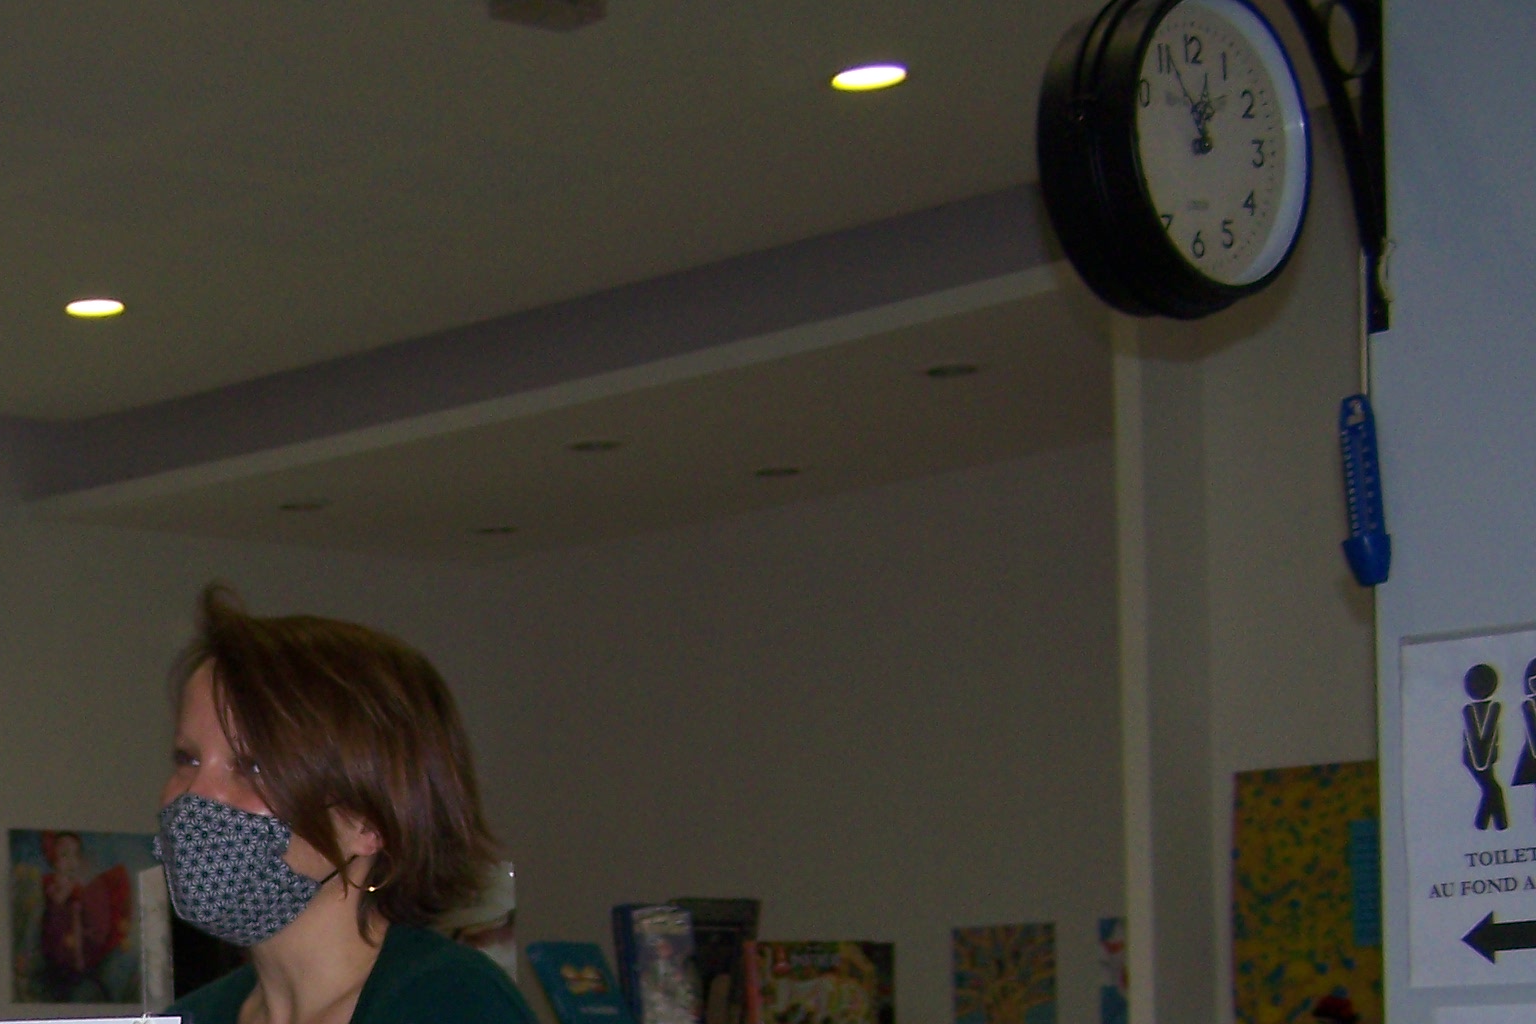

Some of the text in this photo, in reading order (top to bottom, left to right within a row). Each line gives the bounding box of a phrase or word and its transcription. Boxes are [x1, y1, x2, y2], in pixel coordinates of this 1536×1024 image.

[1157, 43, 1172, 74] 11
[1184, 33, 1203, 64] 12
[1138, 79, 1150, 108] 0
[1241, 89, 1255, 119] 2
[1251, 139, 1265, 168] 3
[1242, 189, 1256, 216] 4
[1191, 230, 1205, 259] 6
[1221, 219, 1234, 249] 5
[1429, 881, 1454, 899] AU
[1460, 876, 1518, 897] FOND
